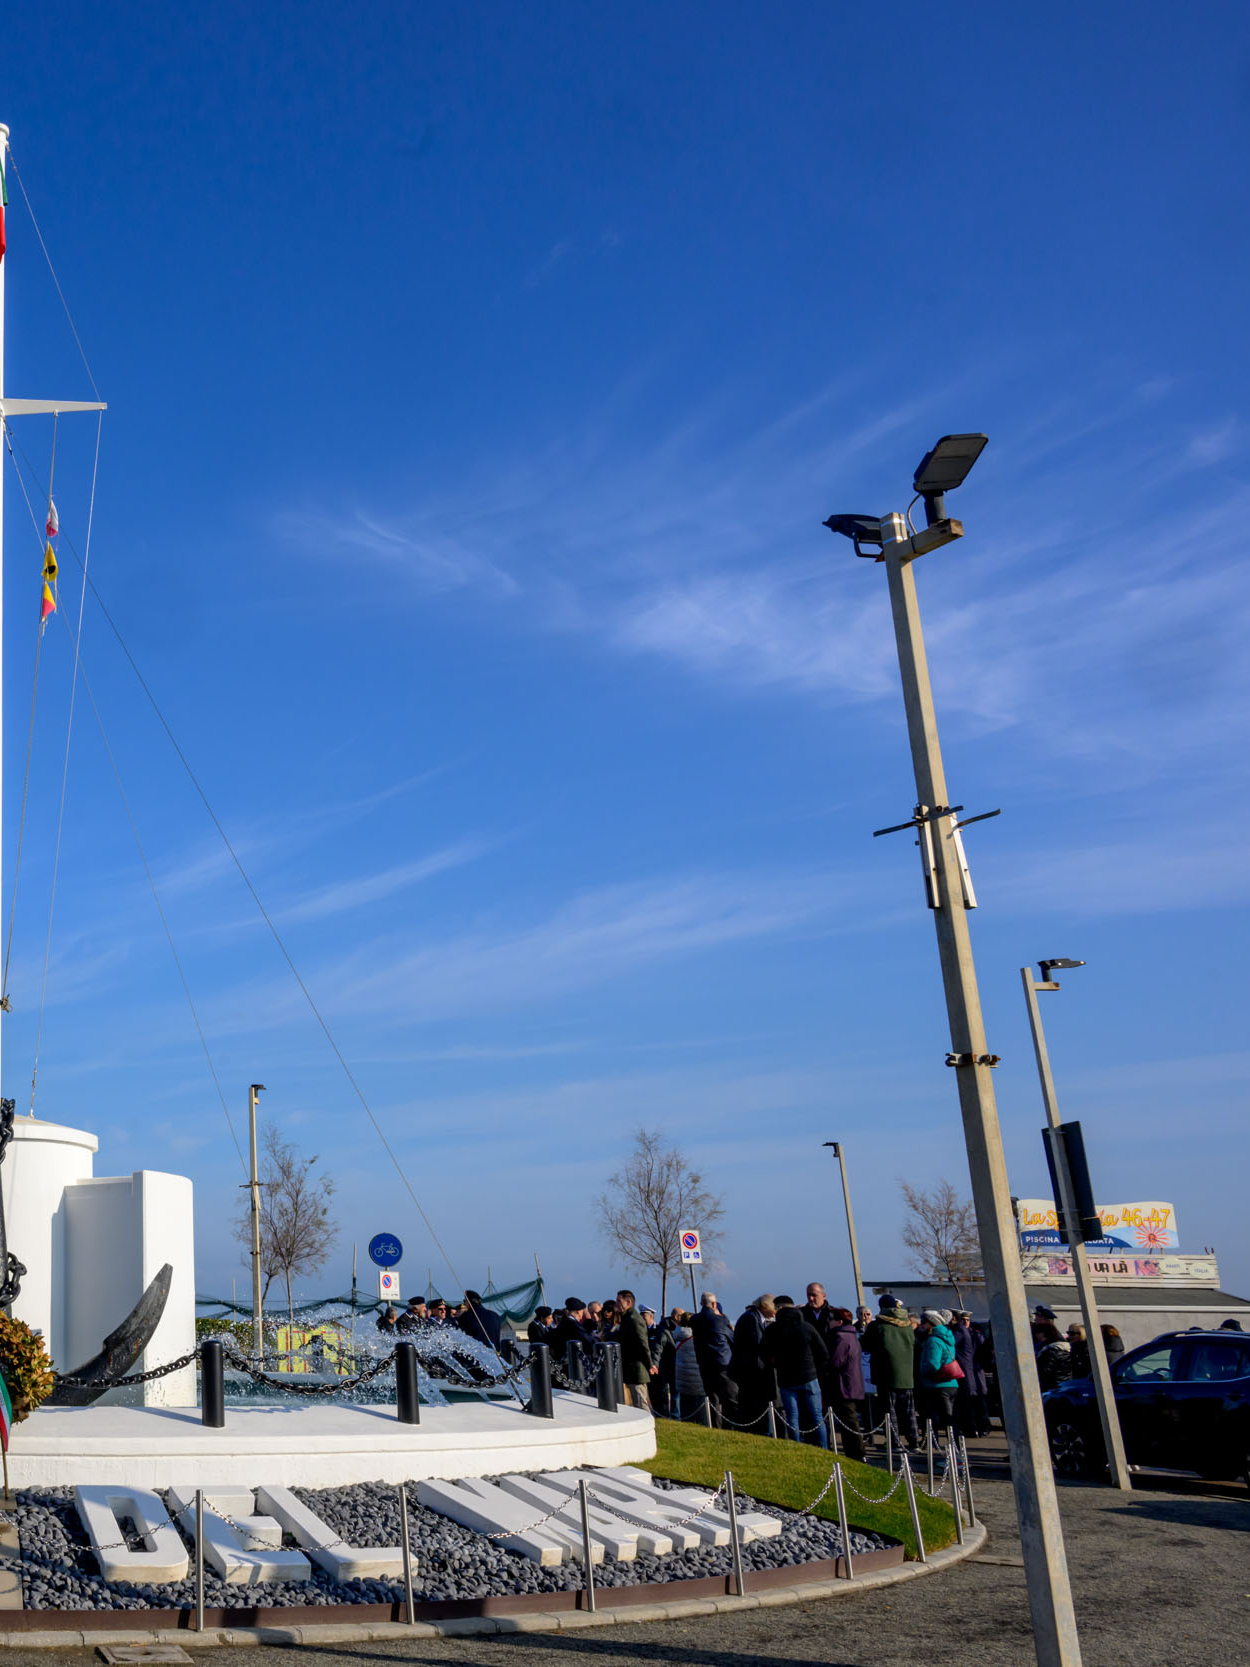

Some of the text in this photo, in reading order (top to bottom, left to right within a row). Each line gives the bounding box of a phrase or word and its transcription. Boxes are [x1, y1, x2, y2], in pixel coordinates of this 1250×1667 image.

[1023, 1208, 1046, 1225] La
[1121, 1207, 1170, 1229] 46-47
[74, 1485, 419, 1584] DEL
[417, 1465, 782, 1566] MARE
